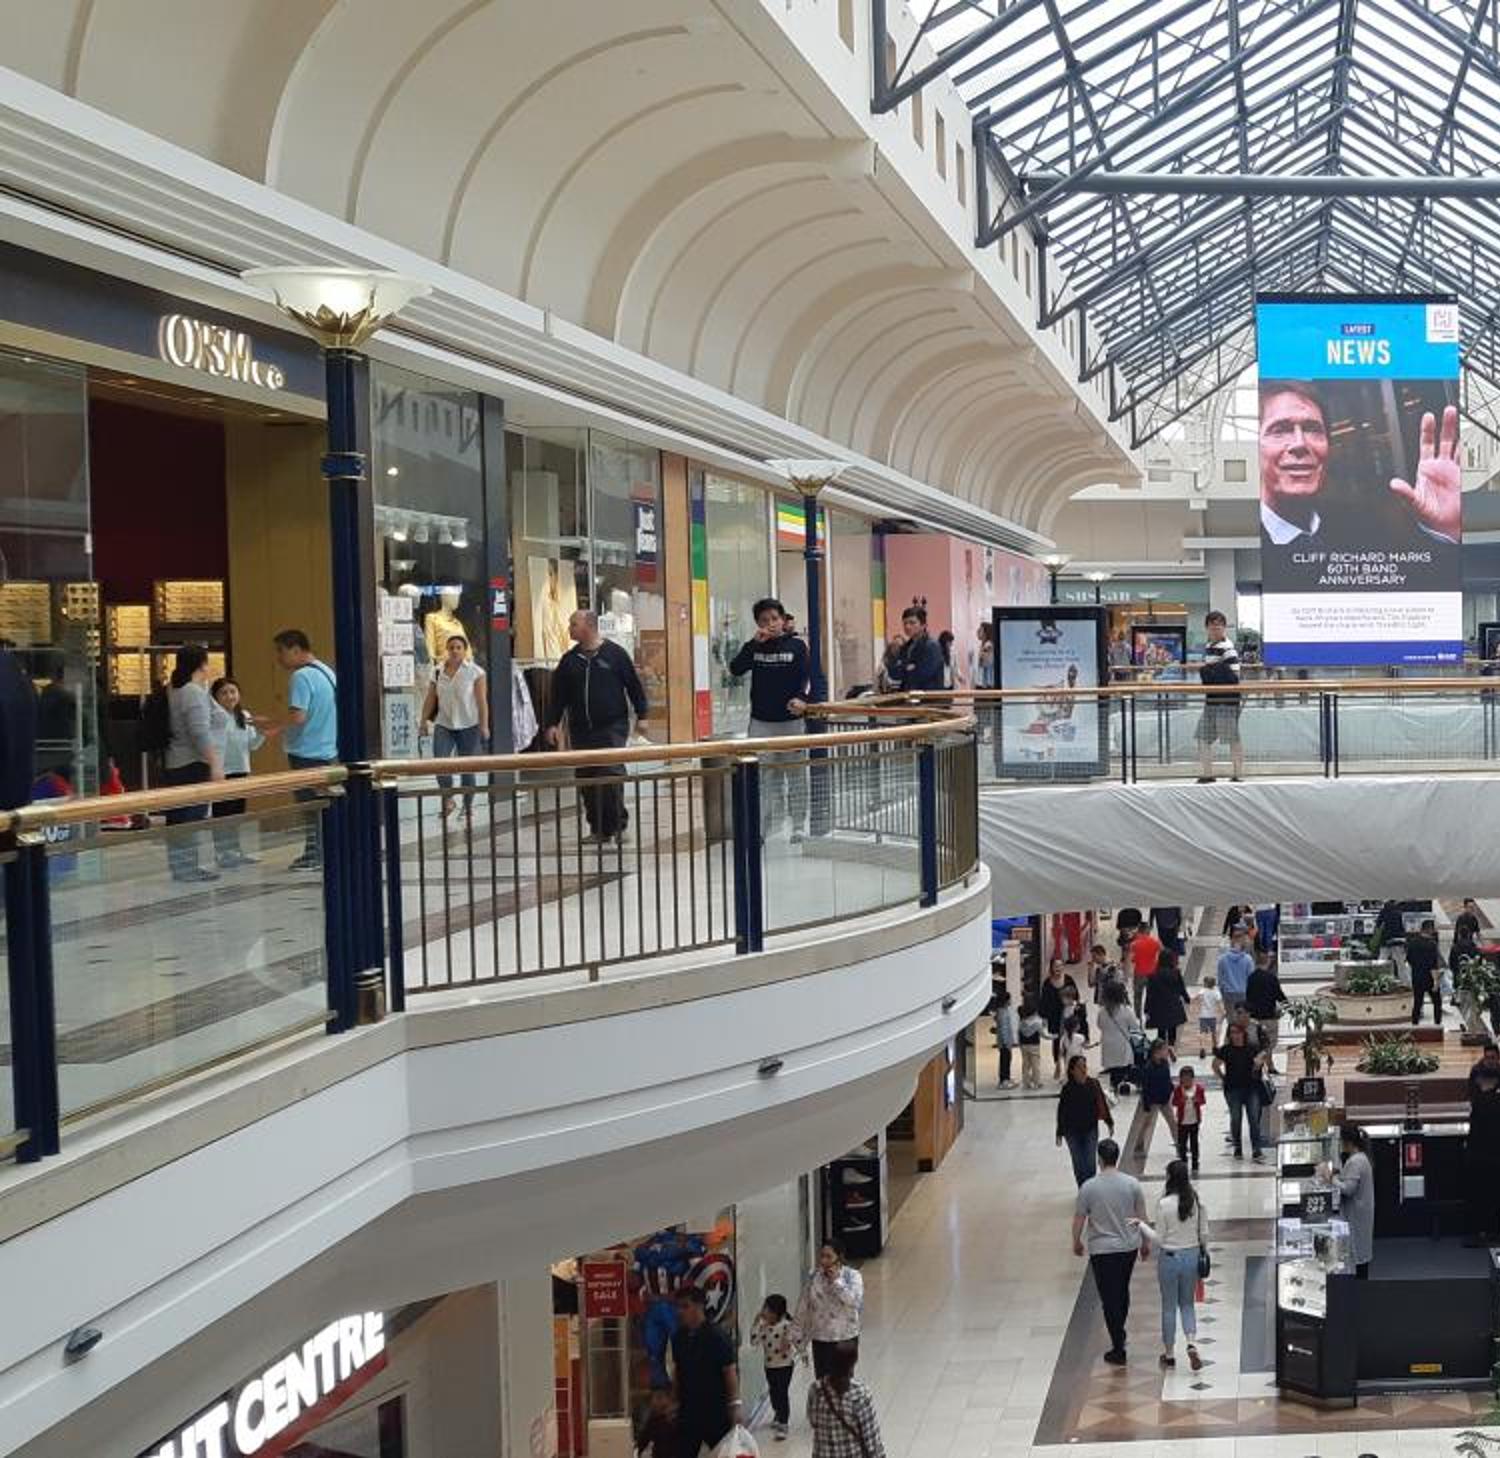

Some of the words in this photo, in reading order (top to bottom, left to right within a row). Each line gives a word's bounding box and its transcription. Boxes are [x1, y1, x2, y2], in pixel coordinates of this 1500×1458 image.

[1327, 339, 1391, 365] NEWS
[1293, 553, 1326, 563] CLIFF
[1330, 552, 1385, 562] RICHARD
[1389, 552, 1431, 562] MARKS
[1327, 564, 1359, 574] 60TH
[1362, 564, 1398, 573] BAND
[1319, 575, 1406, 585] ANNIVERSARY
[391, 725, 409, 746] OFF
[234, 1311, 386, 1456] CENTRE
